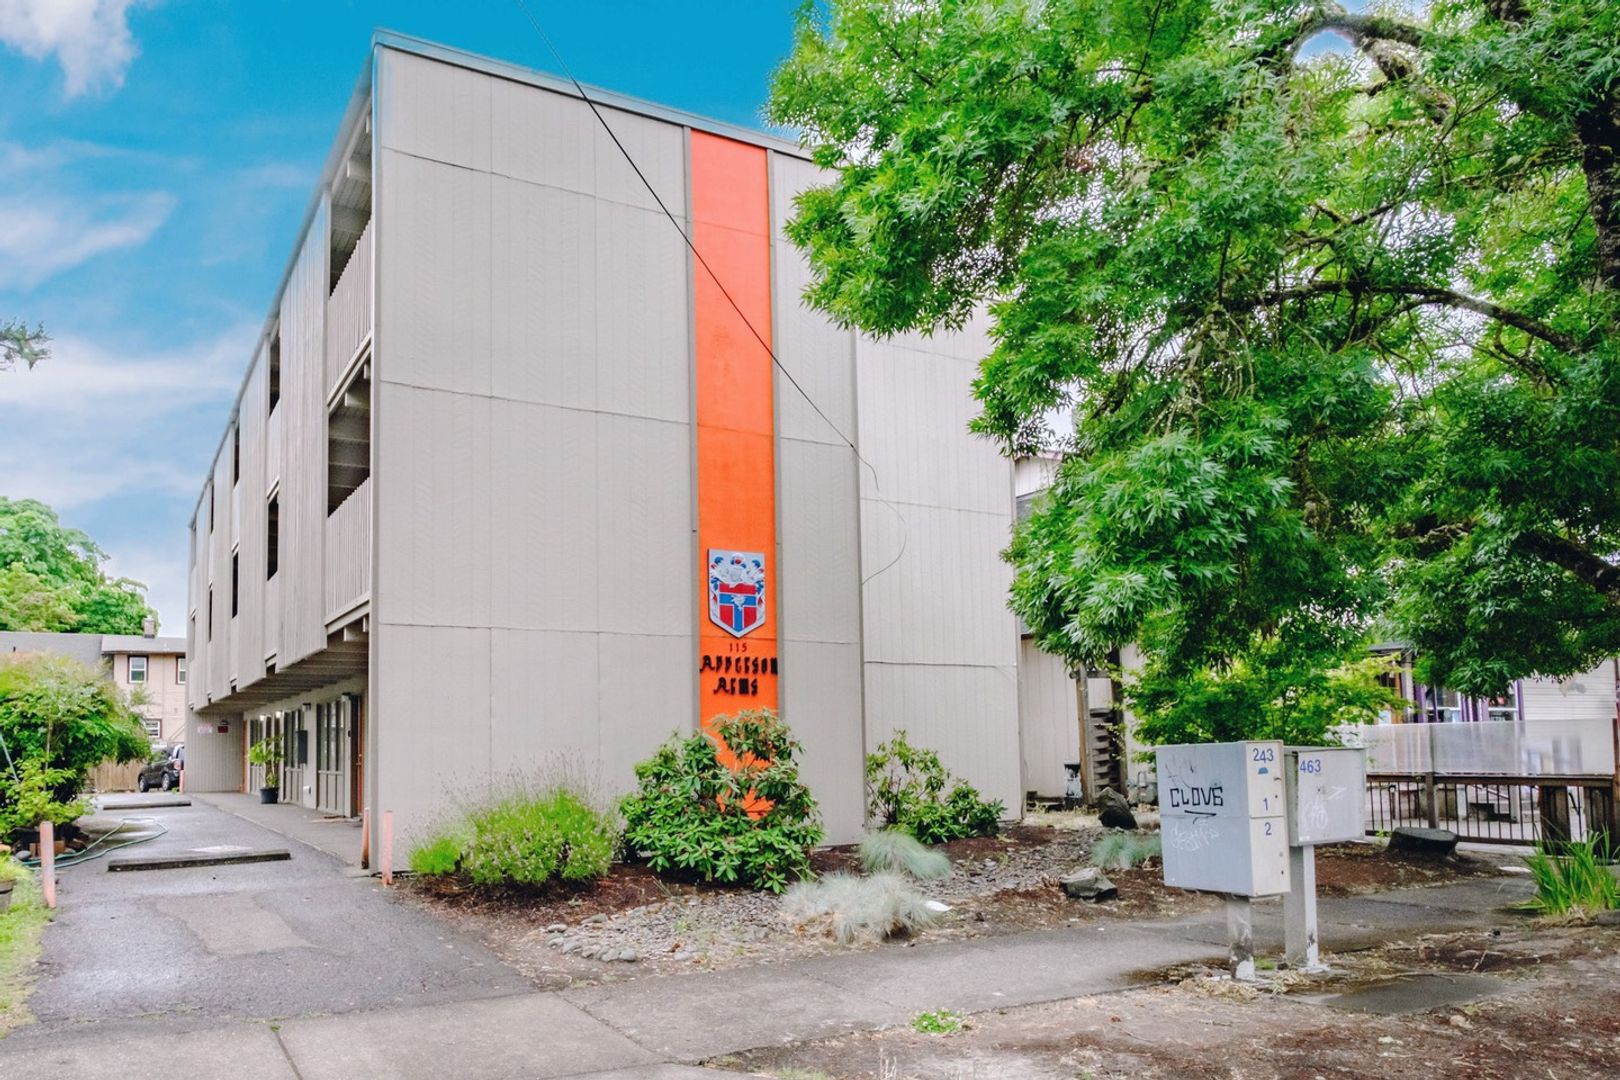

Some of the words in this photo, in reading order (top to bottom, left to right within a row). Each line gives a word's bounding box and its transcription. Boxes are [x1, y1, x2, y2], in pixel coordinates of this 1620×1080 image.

[729, 642, 747, 652] 115
[1252, 748, 1274, 763] 243
[1299, 760, 1321, 773] 463
[1263, 797, 1269, 811] 1
[1264, 822, 1272, 836] 2
